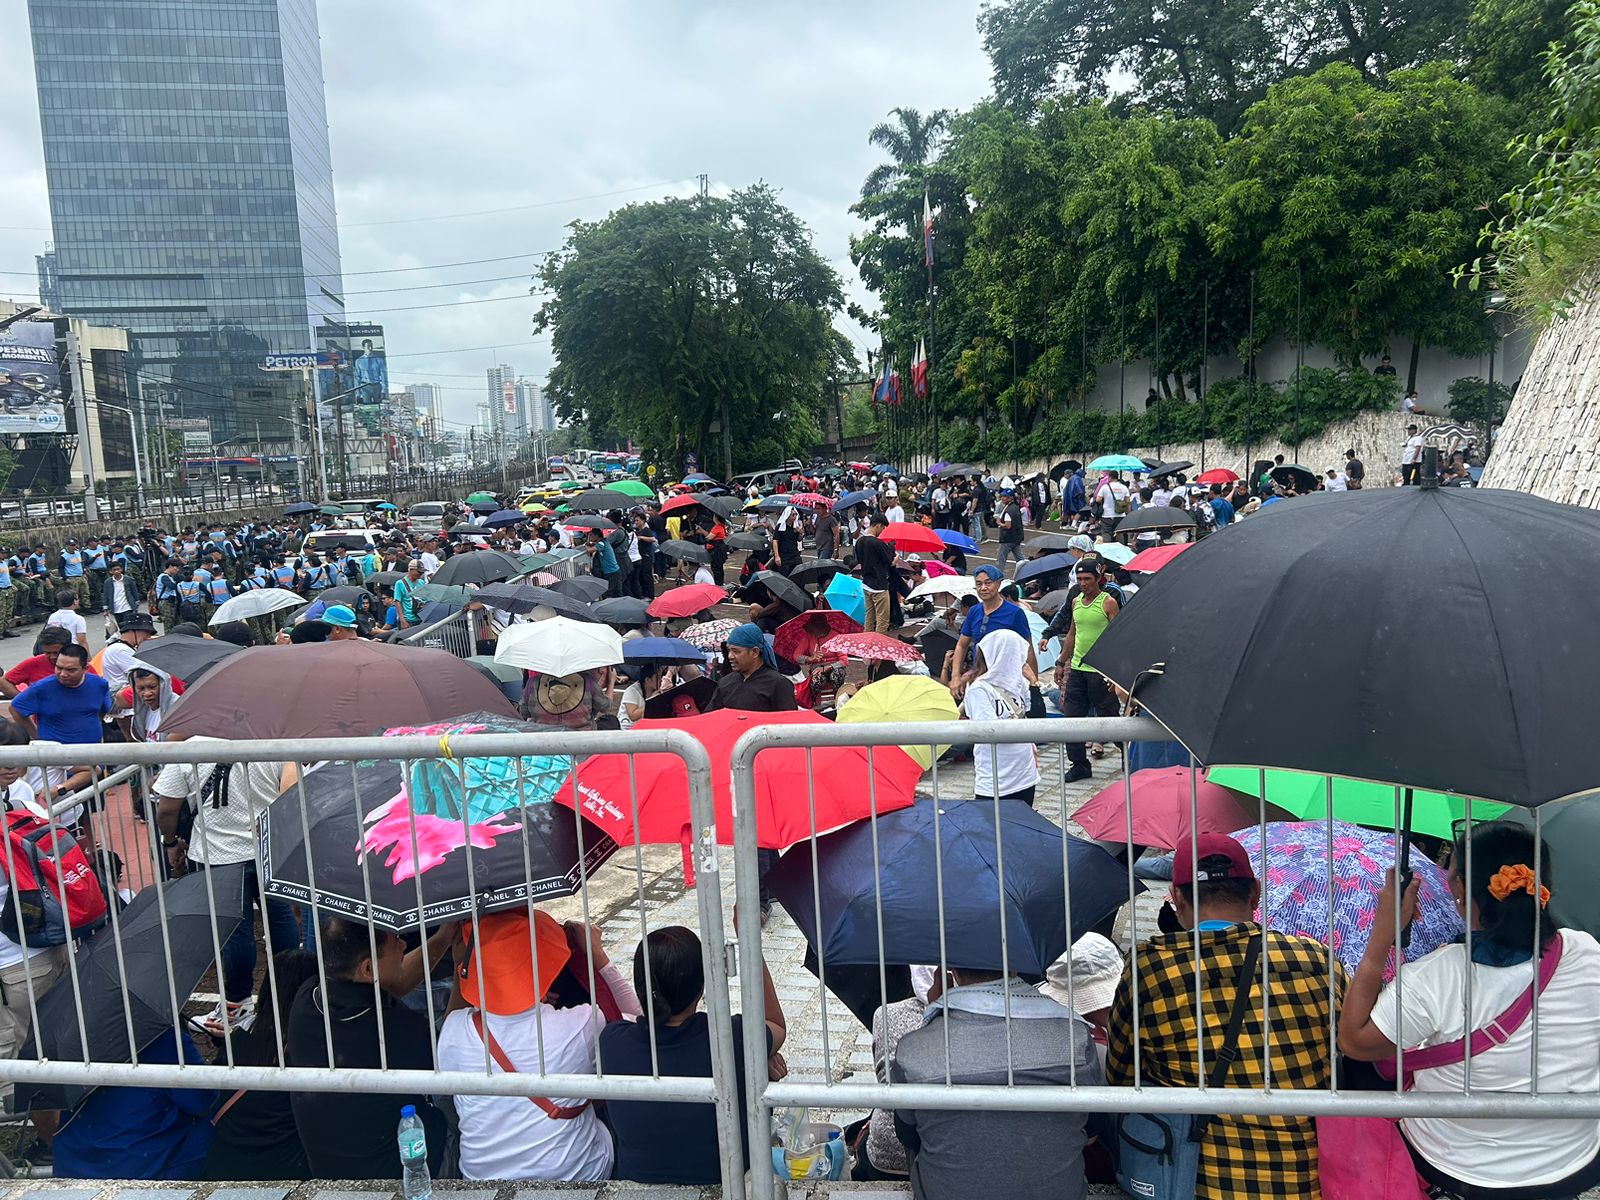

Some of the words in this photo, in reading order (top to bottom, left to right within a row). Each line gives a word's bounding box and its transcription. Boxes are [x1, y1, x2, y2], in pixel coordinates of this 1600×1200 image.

[2, 353, 47, 362] MOMENTS
[265, 356, 317, 368] PETRON
[282, 885, 309, 899] CHANEL
[324, 897, 351, 911] CHANEL
[371, 909, 396, 923] HANEL
[422, 903, 457, 918] CHANEL
[477, 892, 511, 904] ANEL
[530, 880, 563, 893] CHANEL
